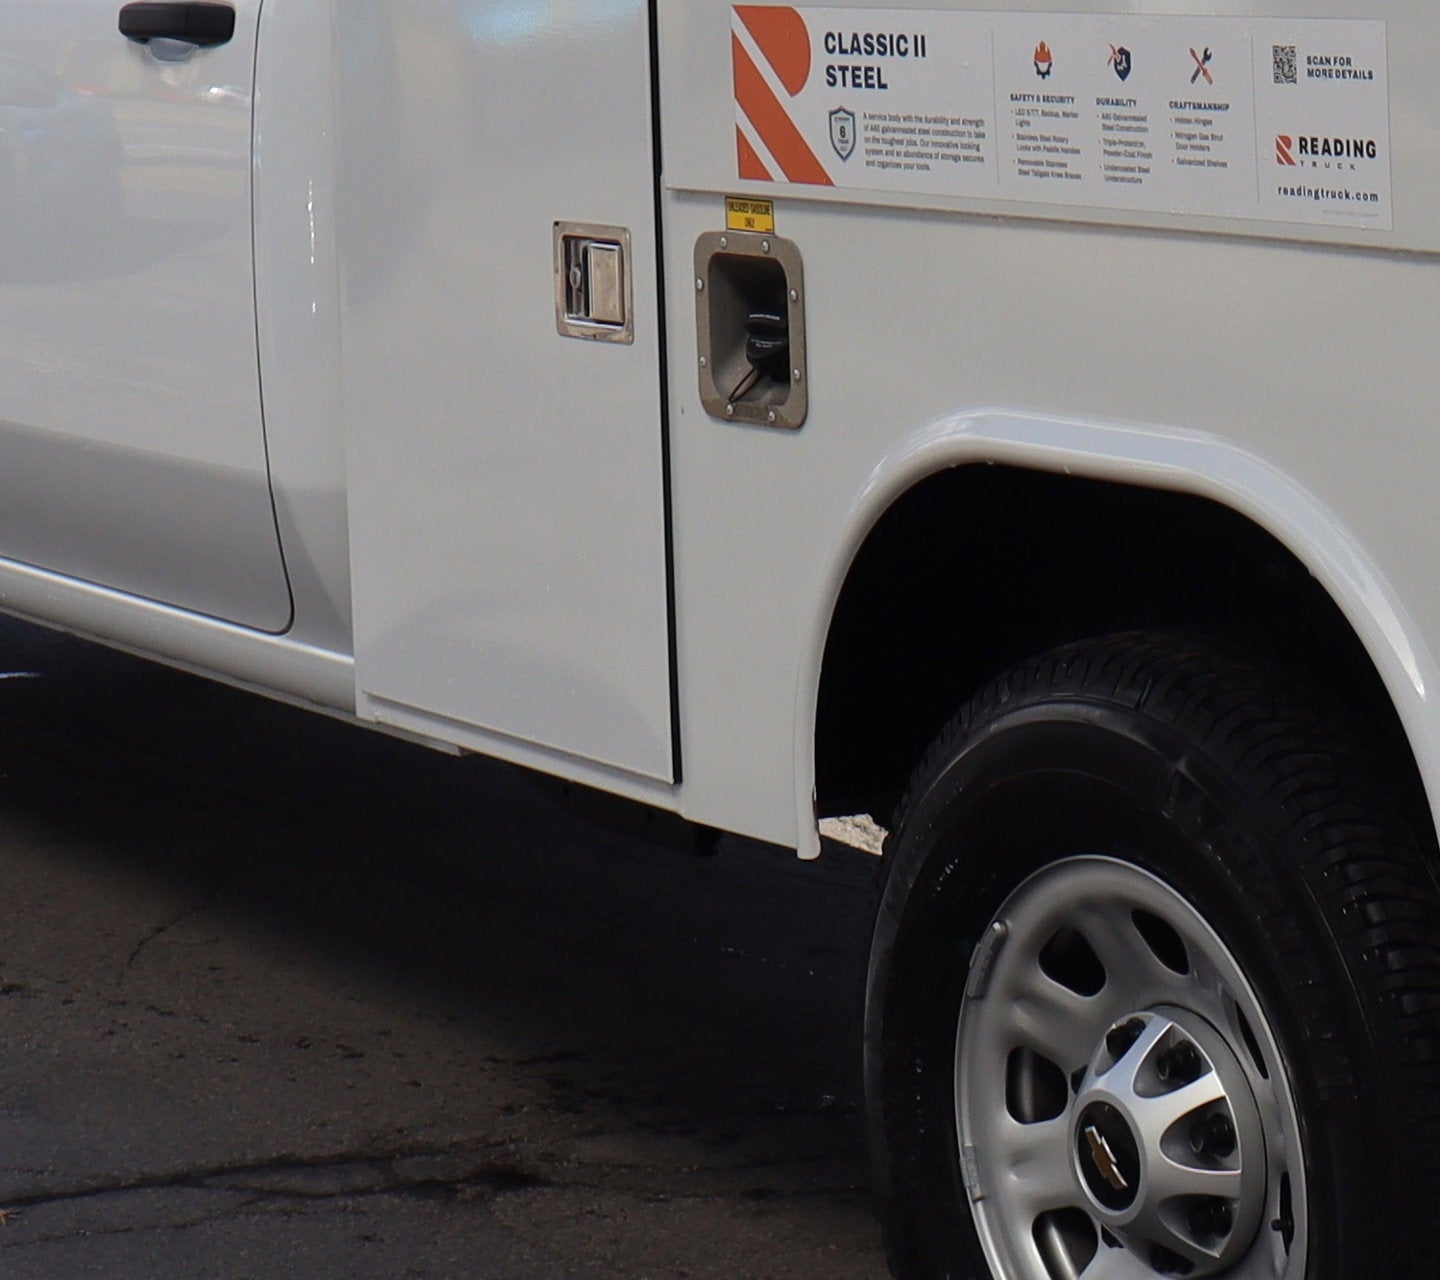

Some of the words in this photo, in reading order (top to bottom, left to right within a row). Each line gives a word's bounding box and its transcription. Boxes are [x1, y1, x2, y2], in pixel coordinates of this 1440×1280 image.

[824, 32, 908, 57] CLASSIC
[913, 34, 926, 58] II
[1306, 56, 1331, 66] SCAN
[1333, 56, 1352, 66] FOR
[826, 64, 888, 90] STEEL
[1307, 68, 1334, 78] MORE
[1336, 70, 1374, 80] DETAILS
[1010, 94, 1035, 102] SAFETY
[1042, 94, 1074, 104] SECURITY
[1096, 97, 1137, 108] DURABILITY
[1168, 101, 1230, 112] CRAFTSMANSHIP
[1298, 136, 1376, 159] READING
[1300, 160, 1356, 170] TRUCK
[1278, 186, 1379, 202] readingtruck.com
